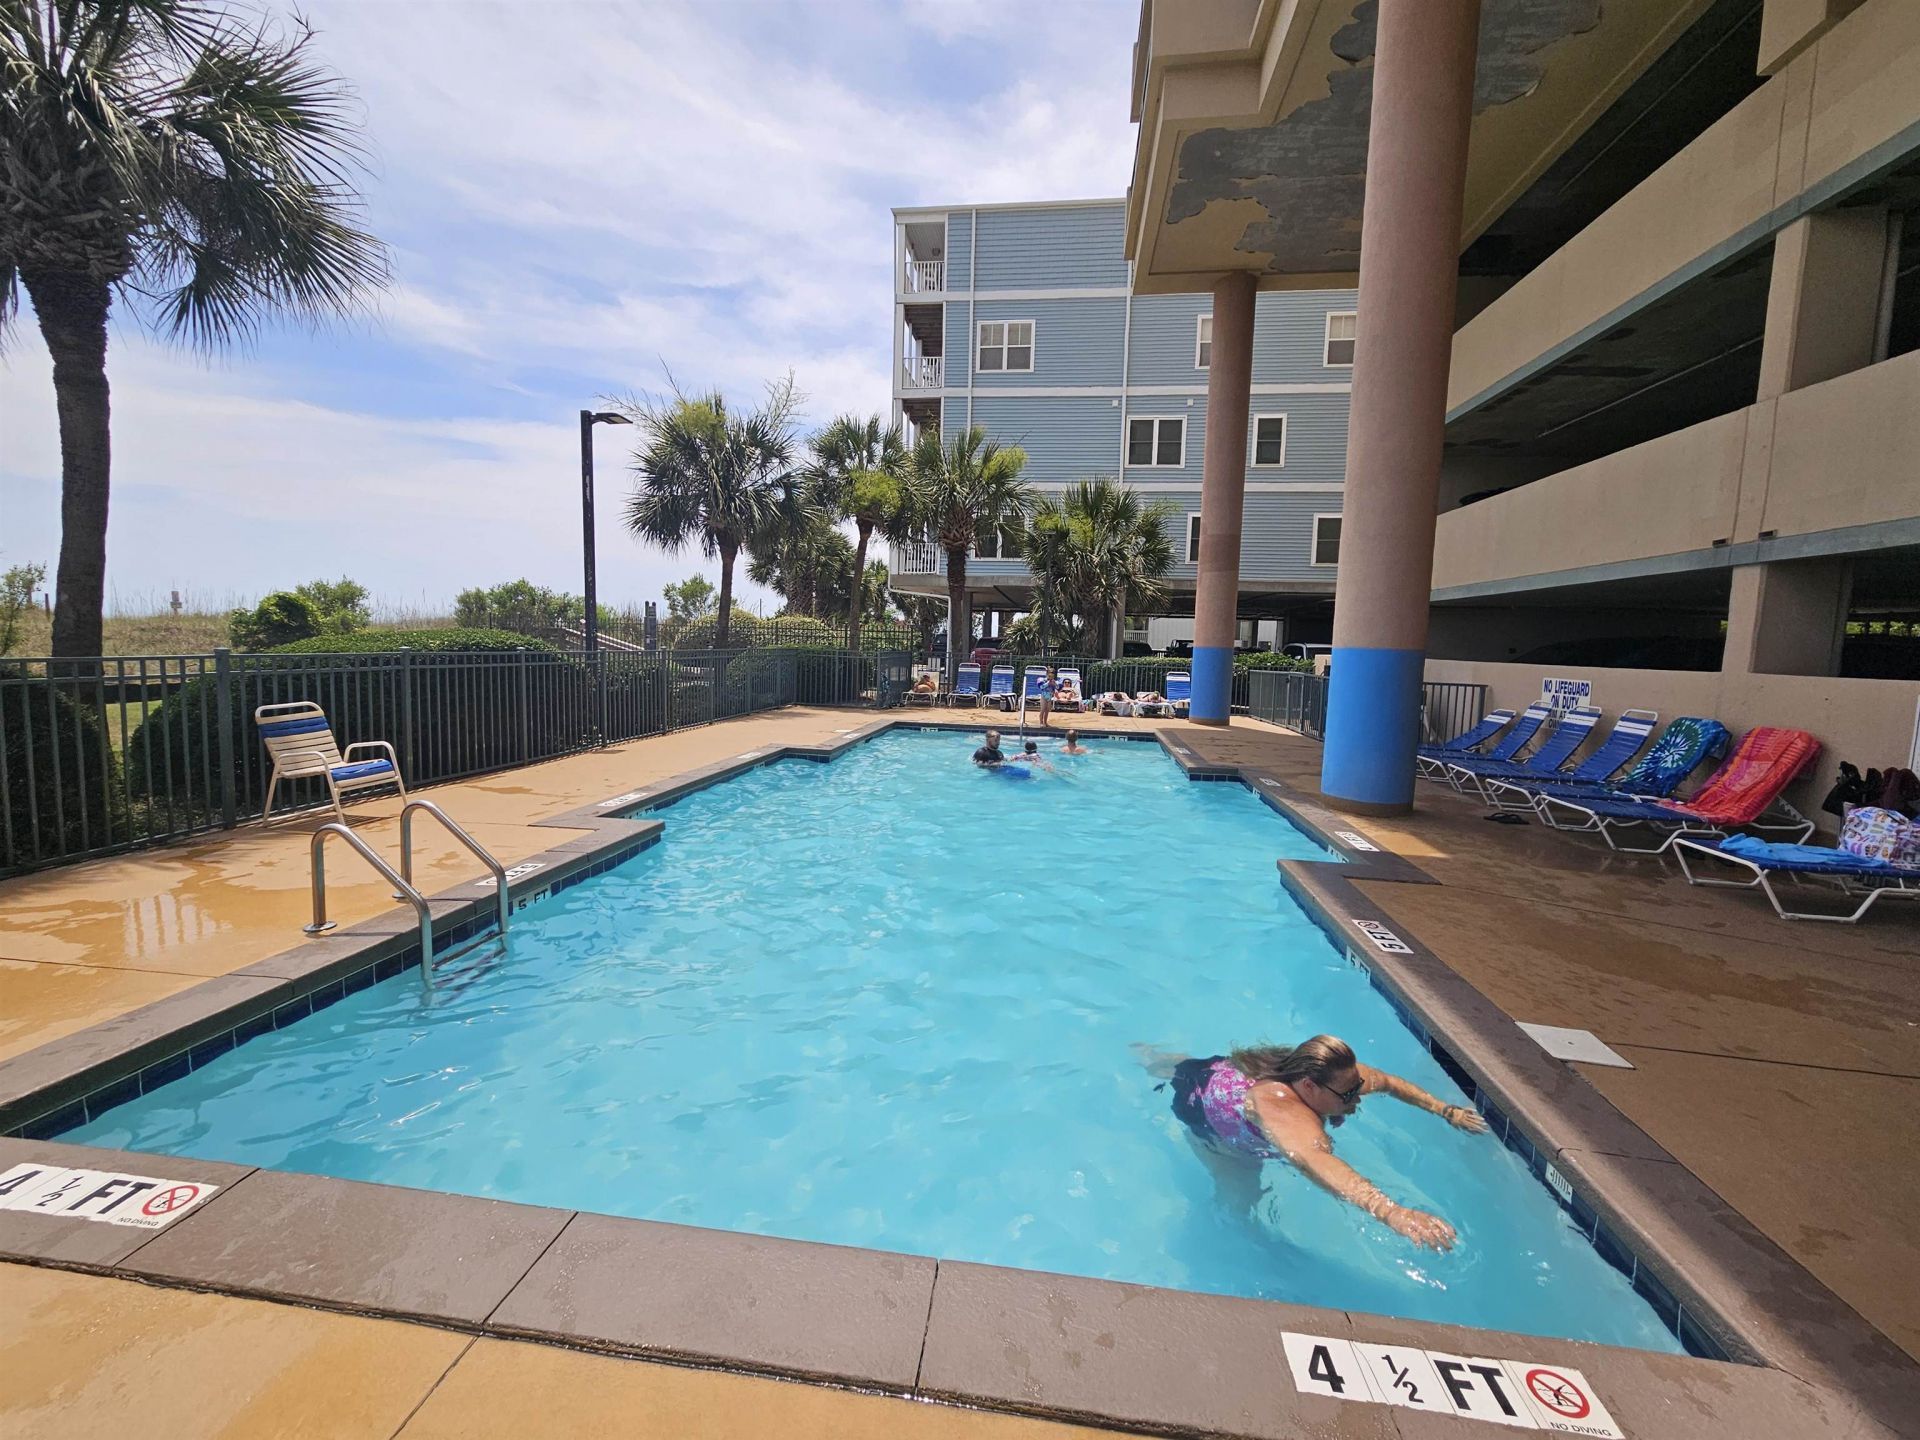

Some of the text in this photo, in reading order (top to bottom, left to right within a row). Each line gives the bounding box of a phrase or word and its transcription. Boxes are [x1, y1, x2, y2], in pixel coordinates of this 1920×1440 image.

[1543, 680, 1590, 697] NO LIFEGUARD
[1551, 695, 1579, 709] ON DUTY
[518, 888, 548, 910] 5 FT
[1366, 930, 1396, 941] FT
[0, 1170, 43, 1196] 4
[66, 1179, 161, 1214] FT
[1308, 1345, 1345, 1393] 4
[1433, 1360, 1518, 1417] FT
[1550, 1421, 1612, 1437] NO DIVING
